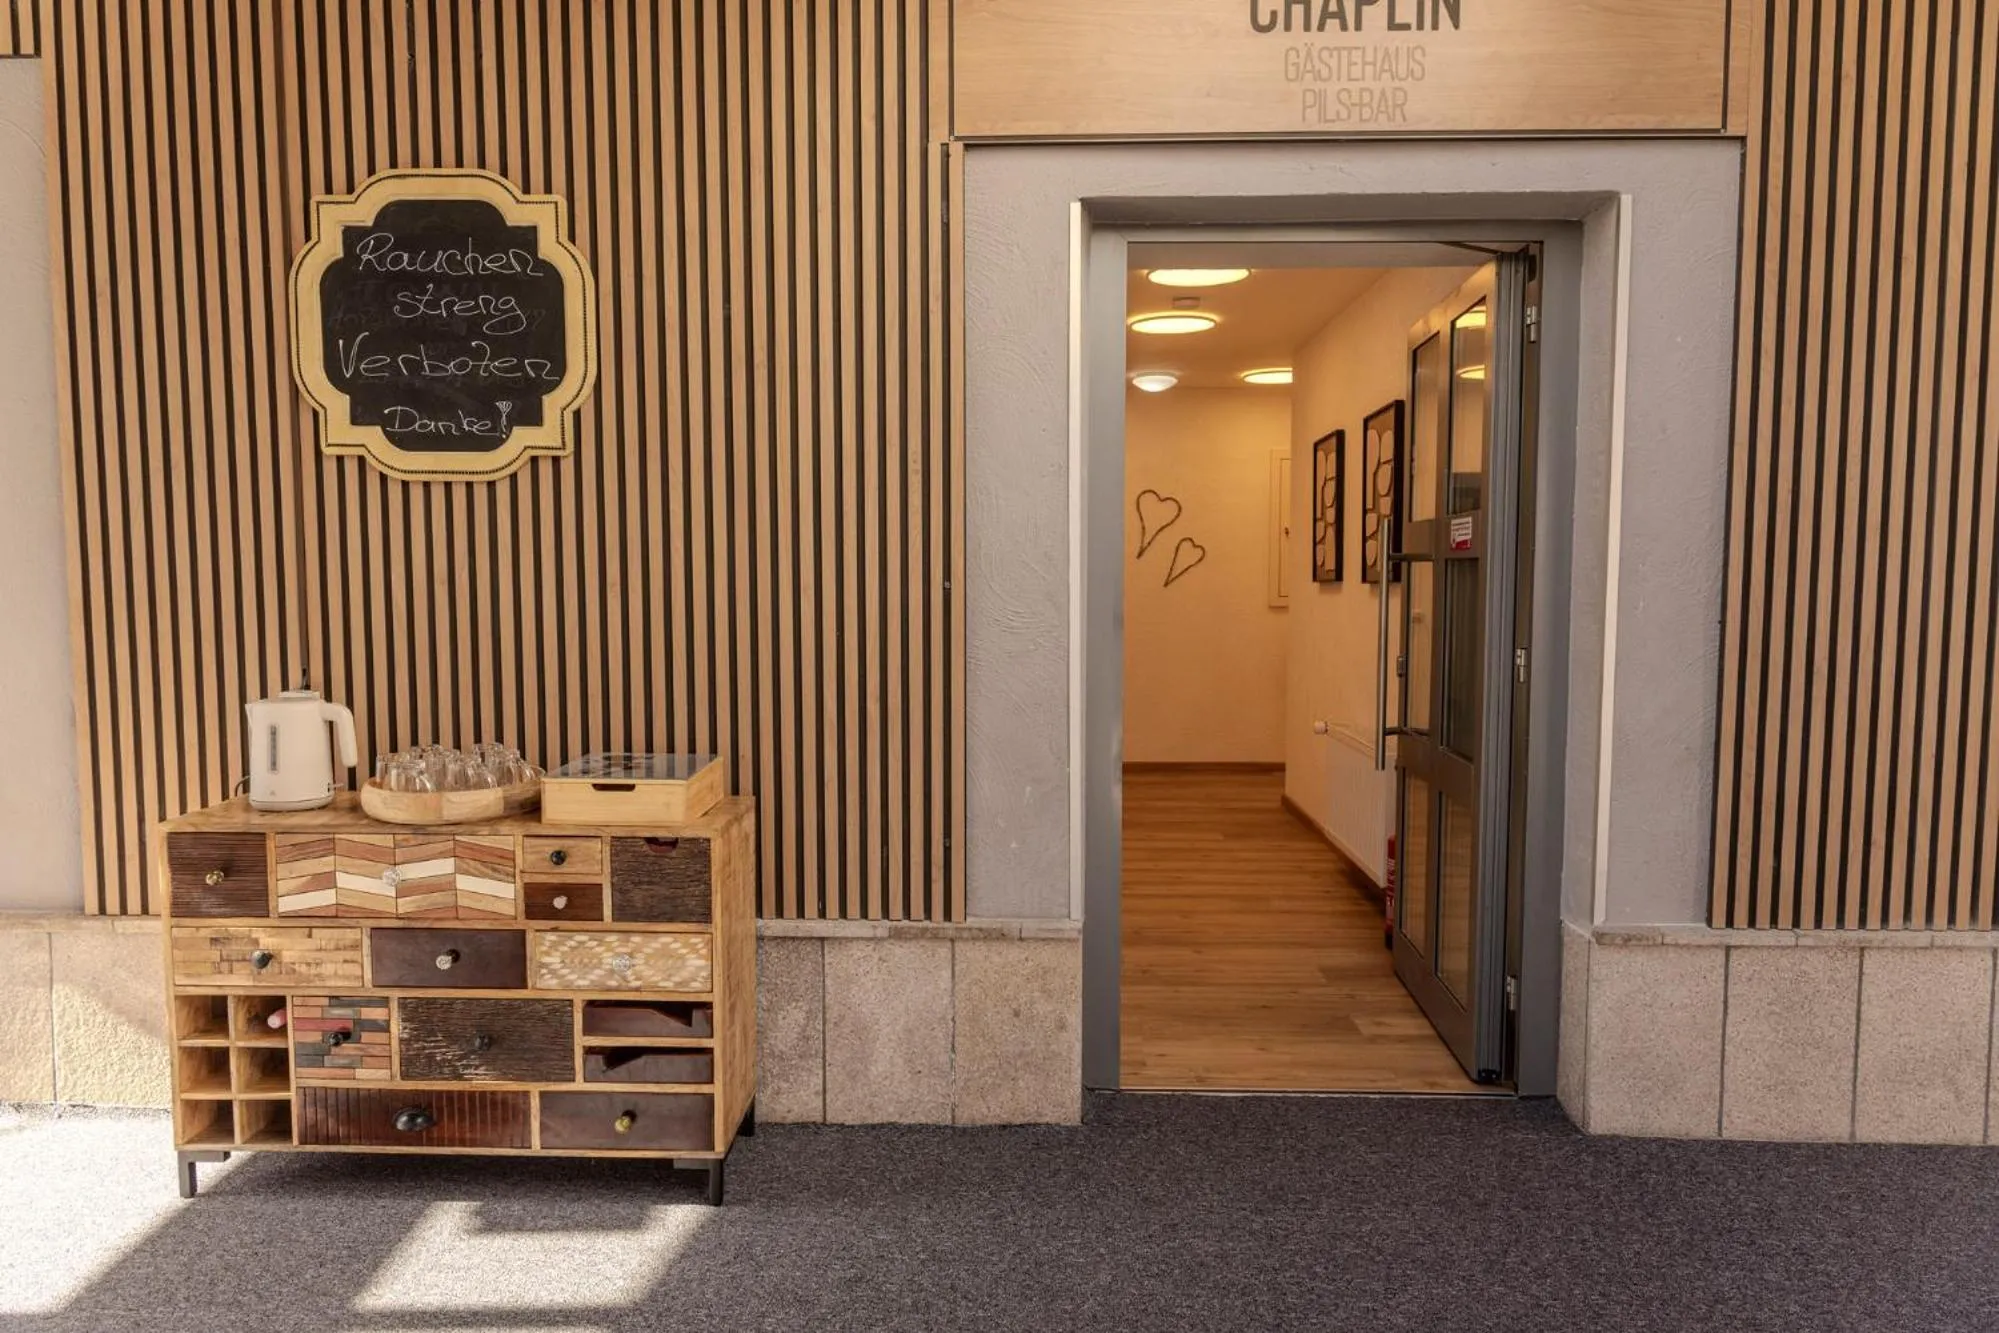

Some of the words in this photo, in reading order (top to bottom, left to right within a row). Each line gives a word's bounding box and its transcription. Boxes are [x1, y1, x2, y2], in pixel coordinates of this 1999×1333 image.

[1250, 0, 1461, 33] CHAPLIN
[1284, 42, 1426, 83] GÄSTEHAUS
[356, 233, 544, 276] Rauchen
[338, 332, 560, 380] Verboten
